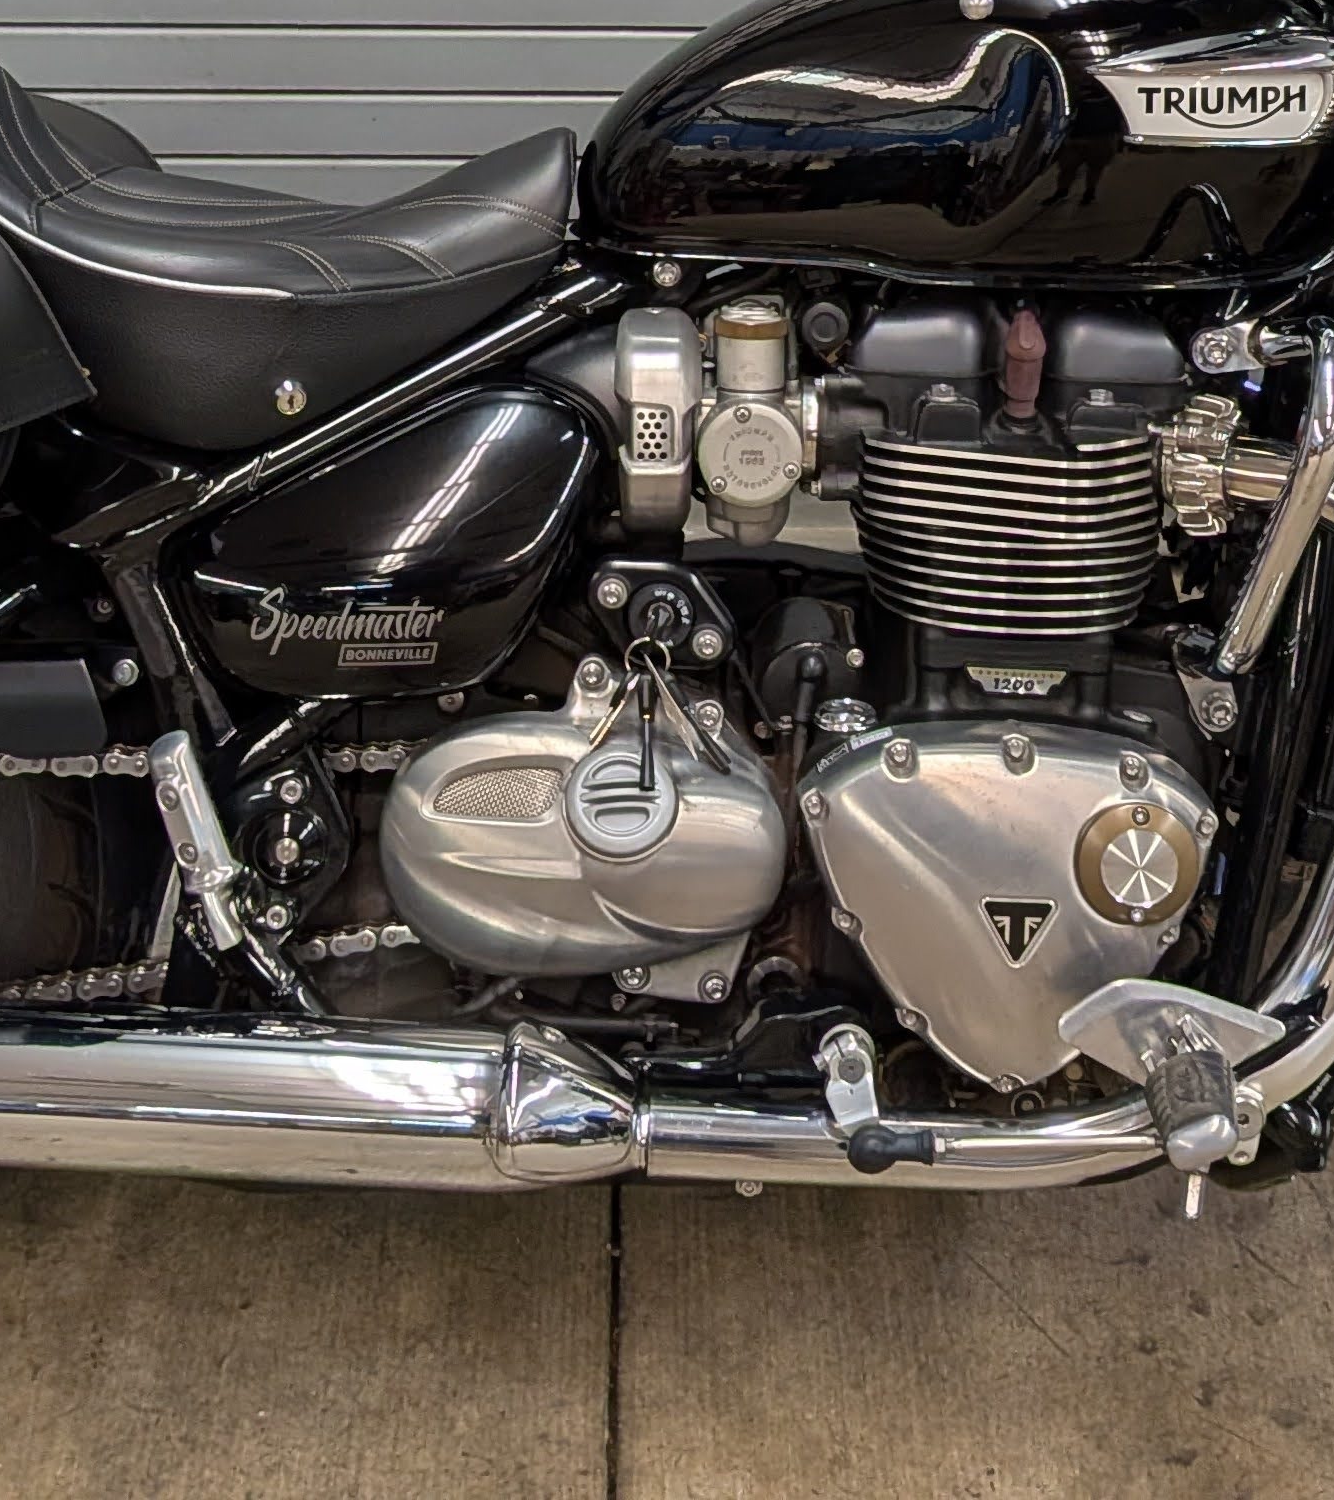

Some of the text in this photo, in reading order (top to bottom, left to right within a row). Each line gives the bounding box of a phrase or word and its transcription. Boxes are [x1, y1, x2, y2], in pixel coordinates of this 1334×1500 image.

[1137, 85, 1306, 129] TRIUMPH
[250, 583, 445, 656] Speedmaster
[344, 647, 431, 662] BONNEVILLE
[993, 677, 1036, 693] 1200
